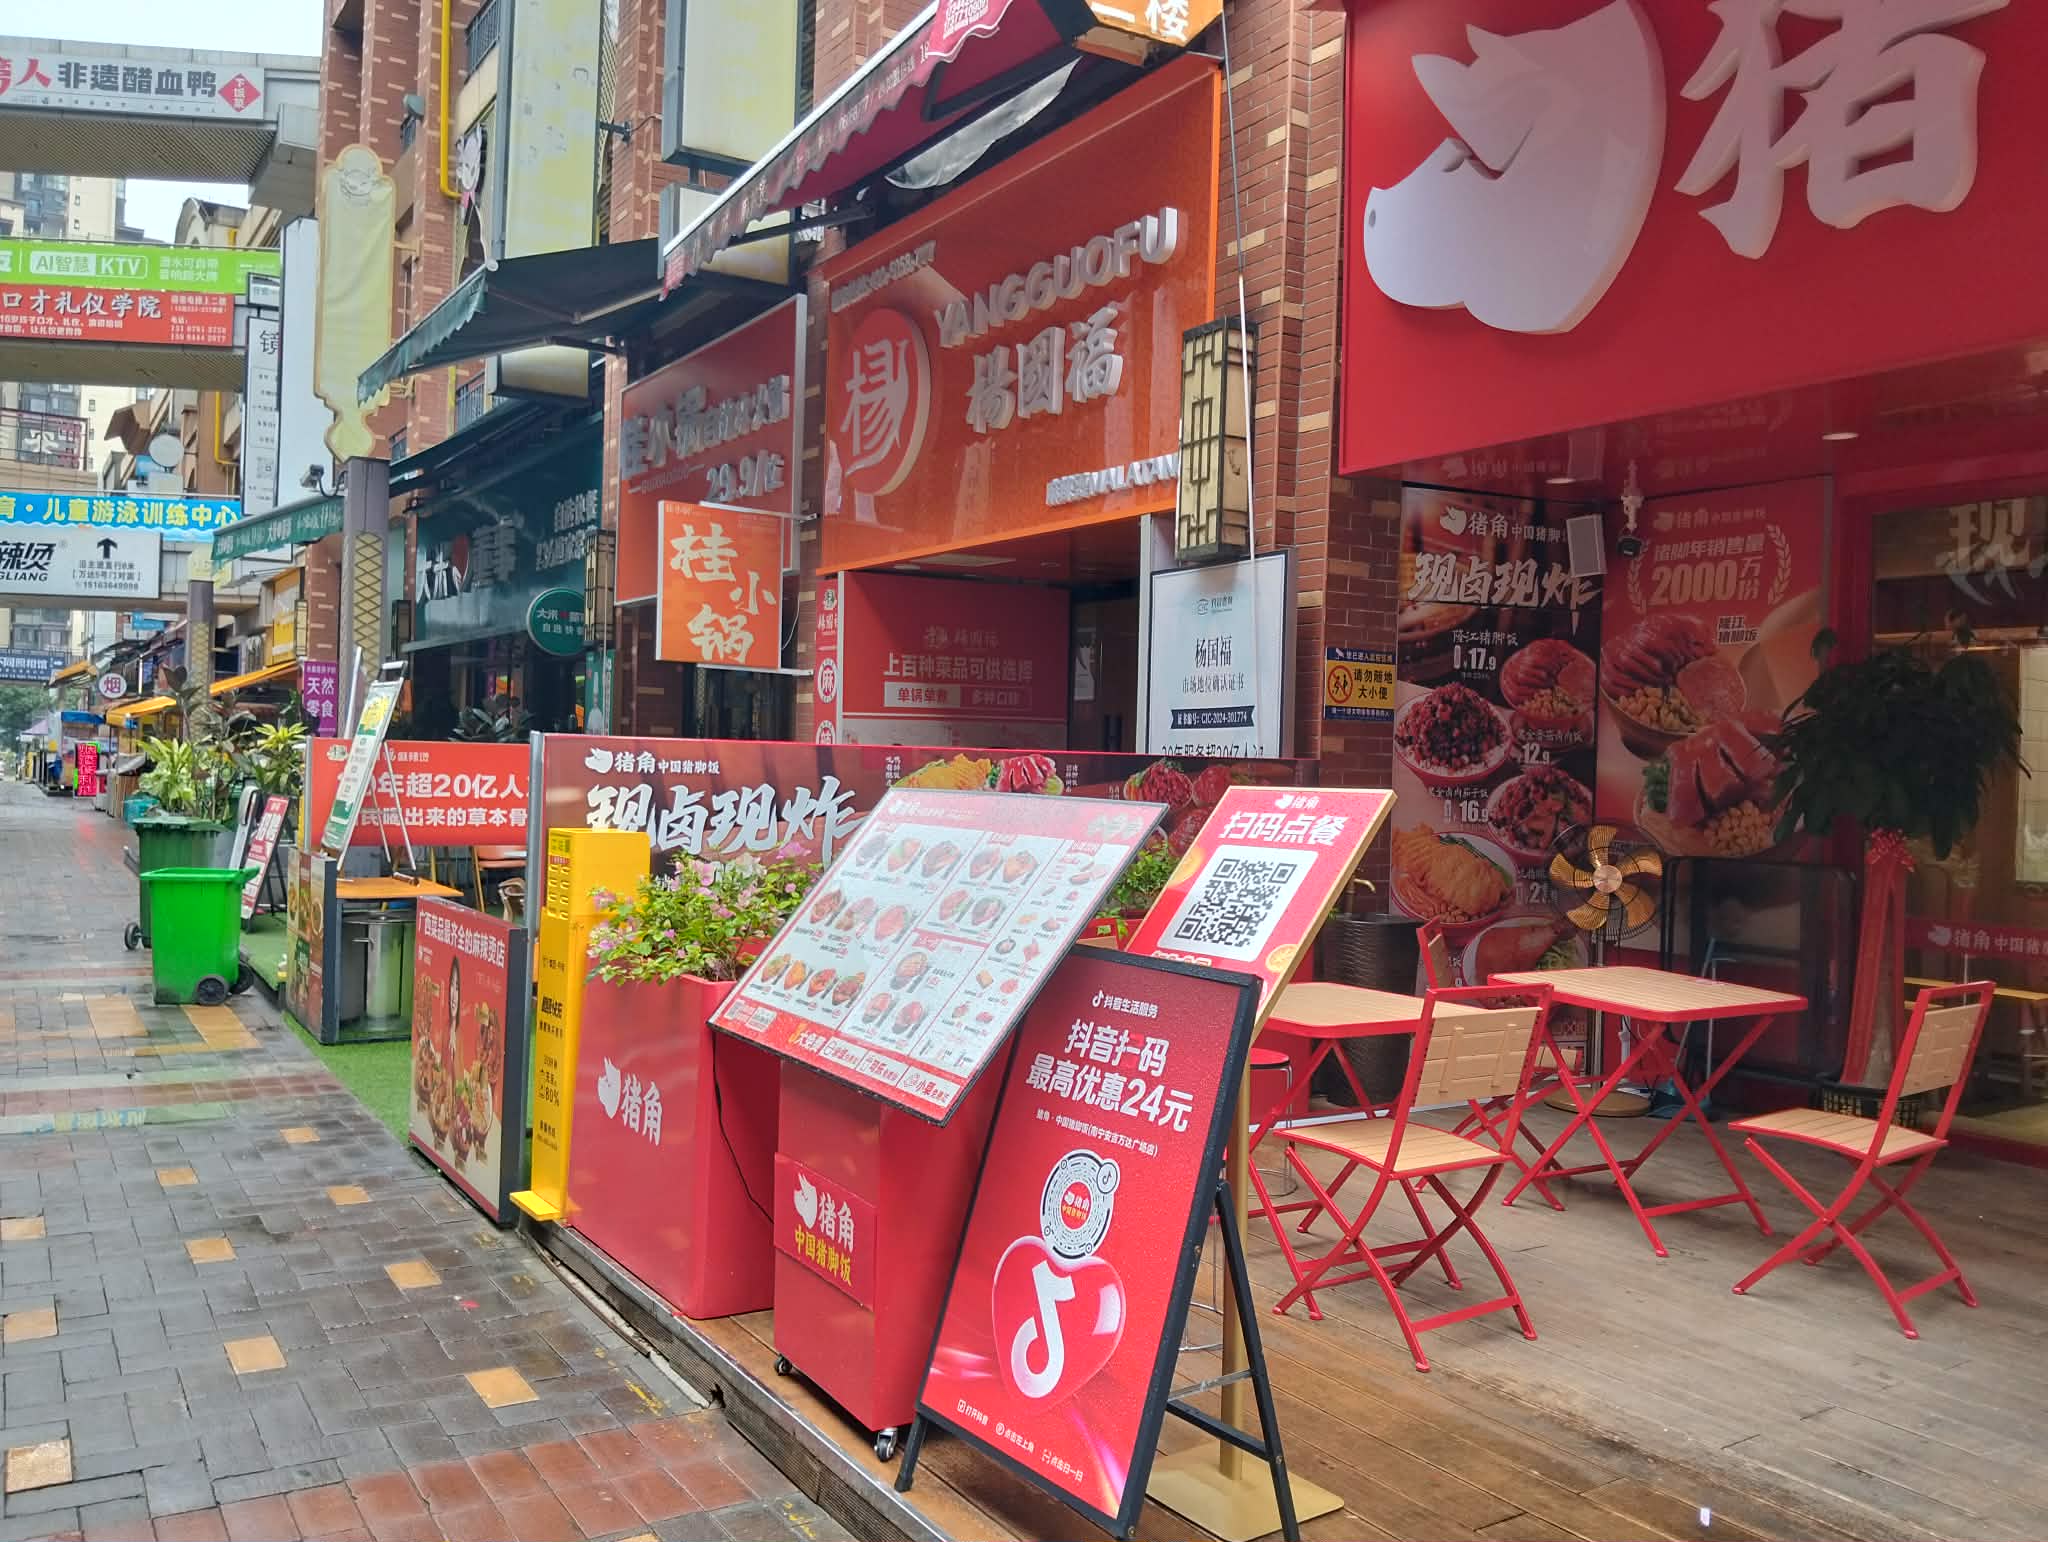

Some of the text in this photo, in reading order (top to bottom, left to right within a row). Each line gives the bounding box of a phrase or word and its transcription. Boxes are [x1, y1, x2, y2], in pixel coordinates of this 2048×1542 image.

[57, 61, 217, 97] 非遗醋血鸭
[1674, 0, 1999, 260] 猪
[100, 256, 141, 276] KTV
[934, 207, 1179, 348] YANGGUOFU
[2, 288, 162, 319] 口才礼仪学院
[1468, 511, 1509, 539] 猪角
[1935, 496, 2048, 606] 现
[1648, 558, 1738, 607] 2000
[1194, 635, 1233, 669] 杨国福
[104, 677, 121, 693] 烟
[306, 677, 335, 695] 天然
[614, 750, 721, 776] 猪角 中国猪脚饭
[354, 807, 529, 829] 民喝出来的草本骨
[586, 776, 874, 876] 现卤现炸
[1218, 811, 1349, 847] 扫码点餐
[1103, 994, 1159, 1019] 抖音生活服务
[1063, 1018, 1170, 1078] 抖音扫码
[620, 1072, 664, 1147] 猪角
[1025, 1052, 1195, 1133] 最高优惠24元
[818, 1191, 855, 1254] 猪角
[794, 1223, 853, 1287] 中国猪脚饭
